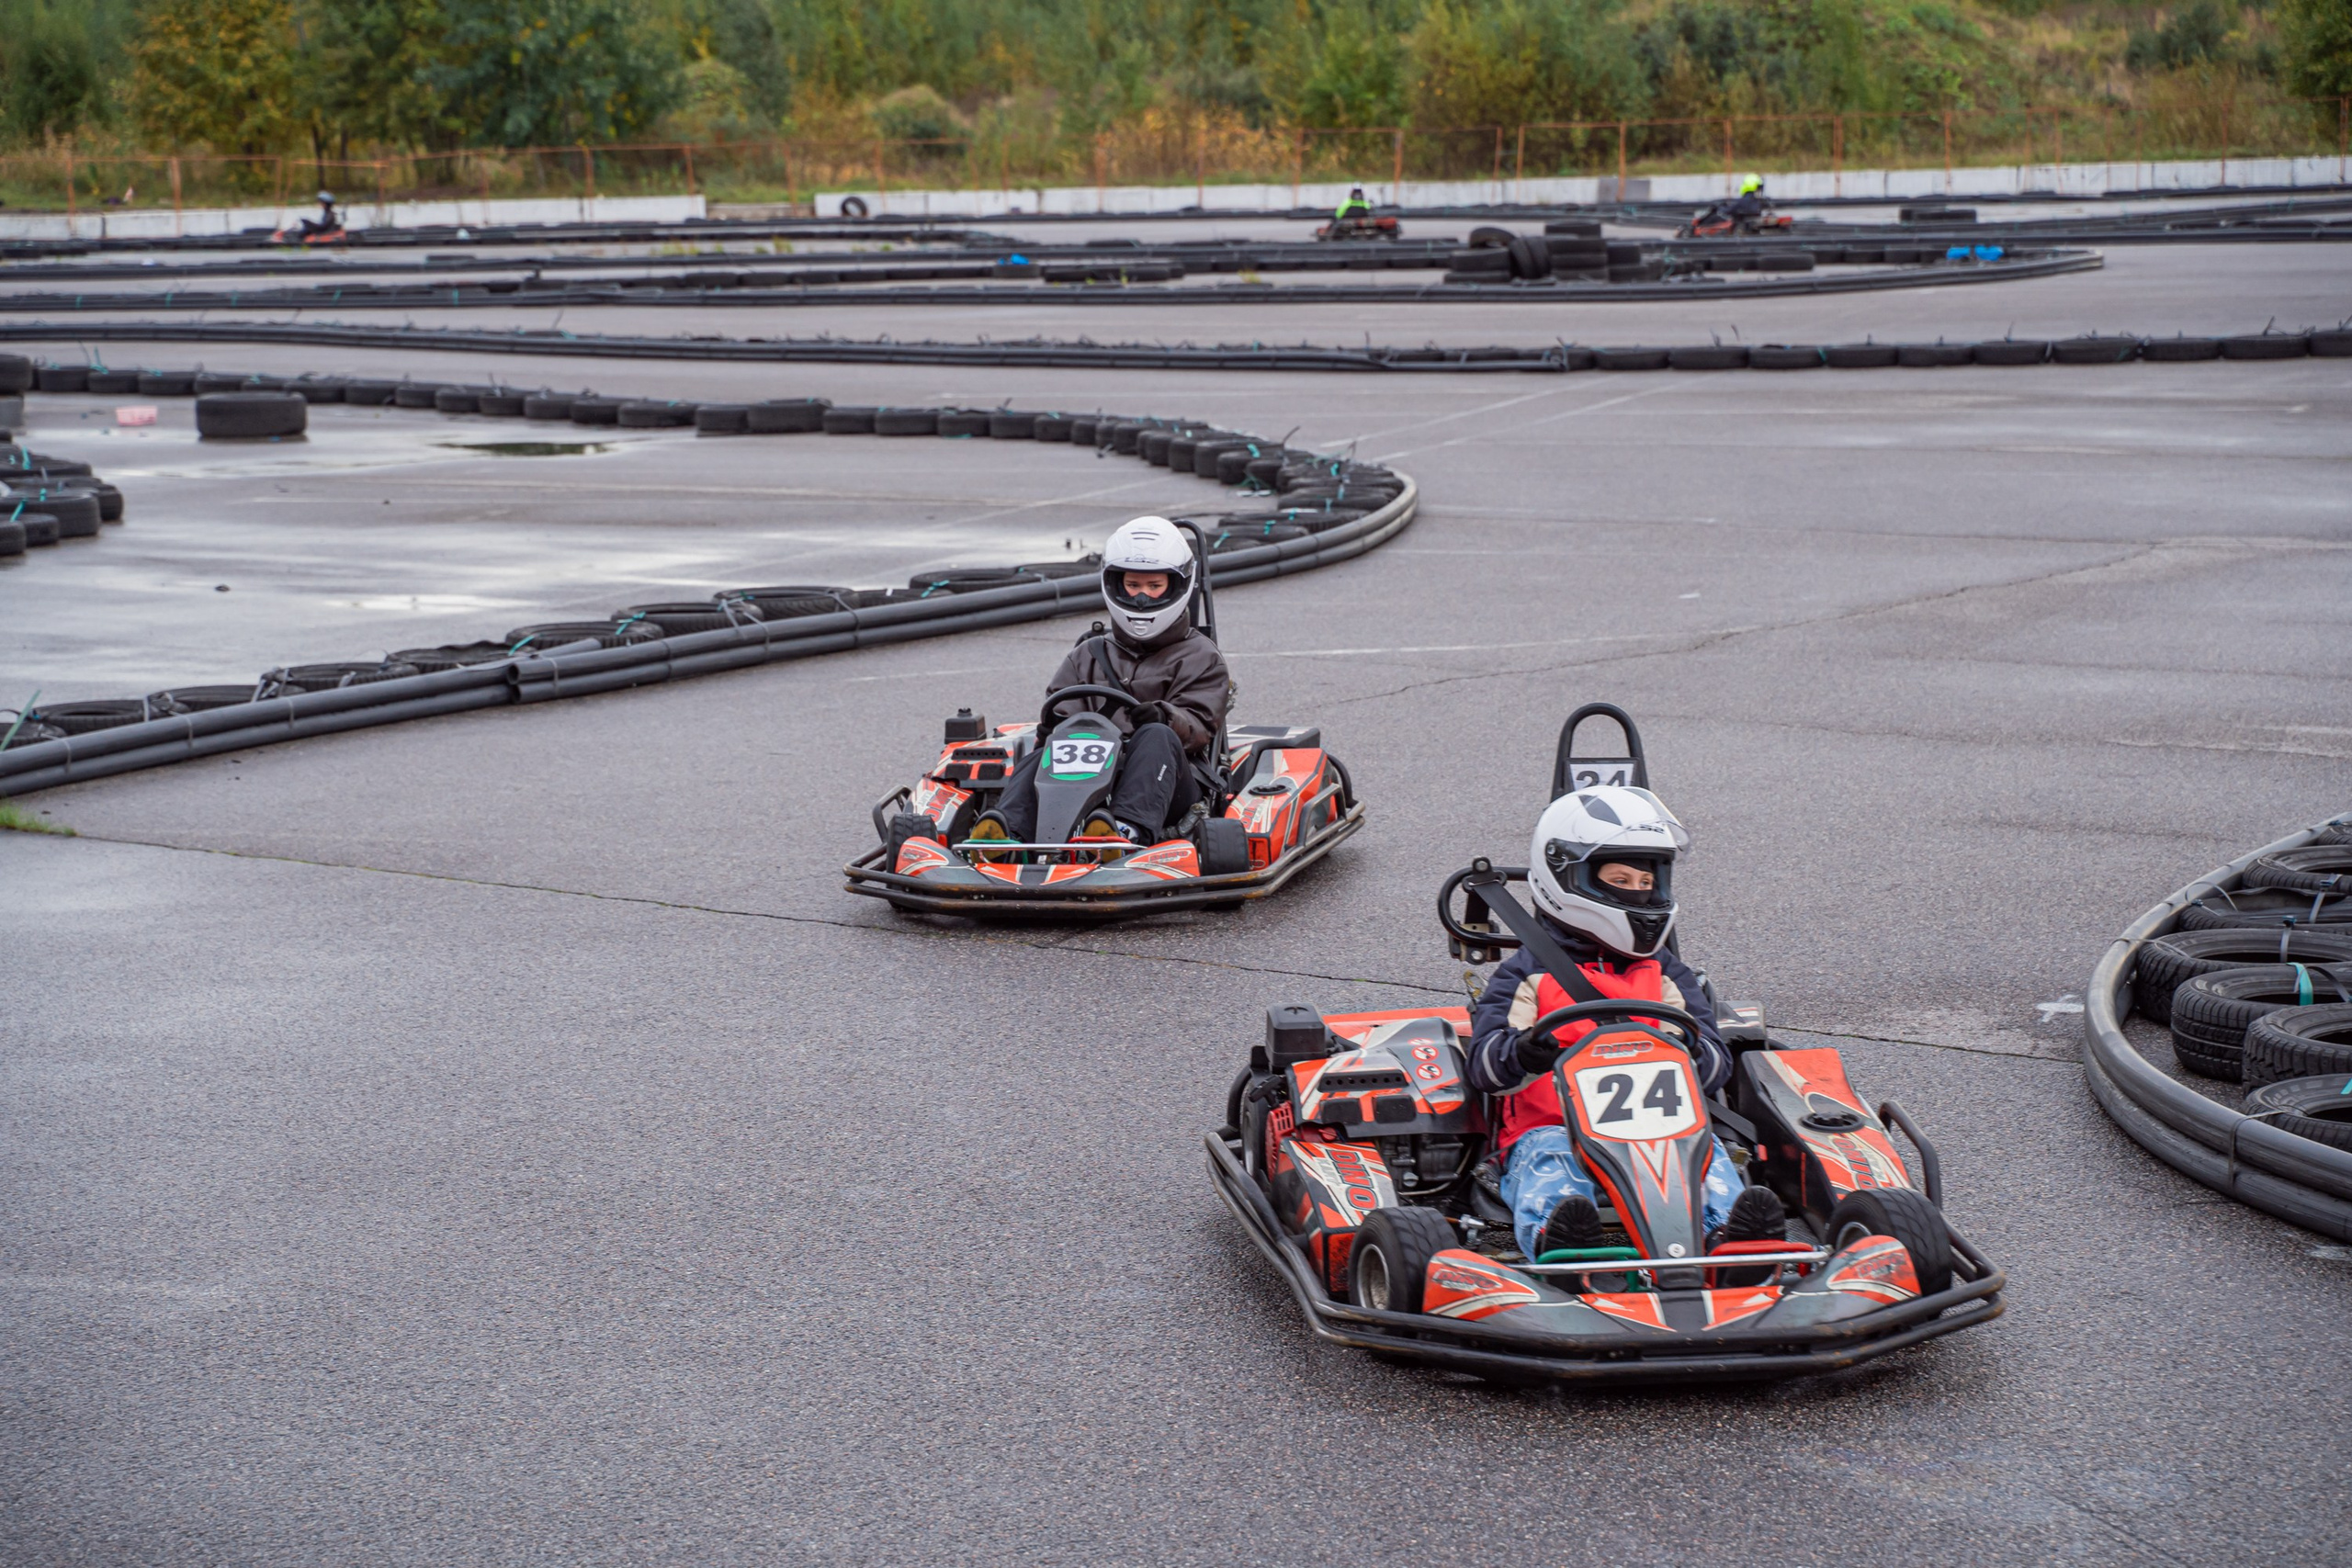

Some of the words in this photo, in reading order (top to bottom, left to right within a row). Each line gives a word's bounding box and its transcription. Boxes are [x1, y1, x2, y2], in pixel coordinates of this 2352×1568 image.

[1053, 744, 1106, 764] 38
[1592, 1041, 1654, 1056] DINO
[1596, 1069, 1682, 1124] 24
[1325, 1148, 1380, 1212] DINO
[1832, 1137, 1879, 1190] DINO
